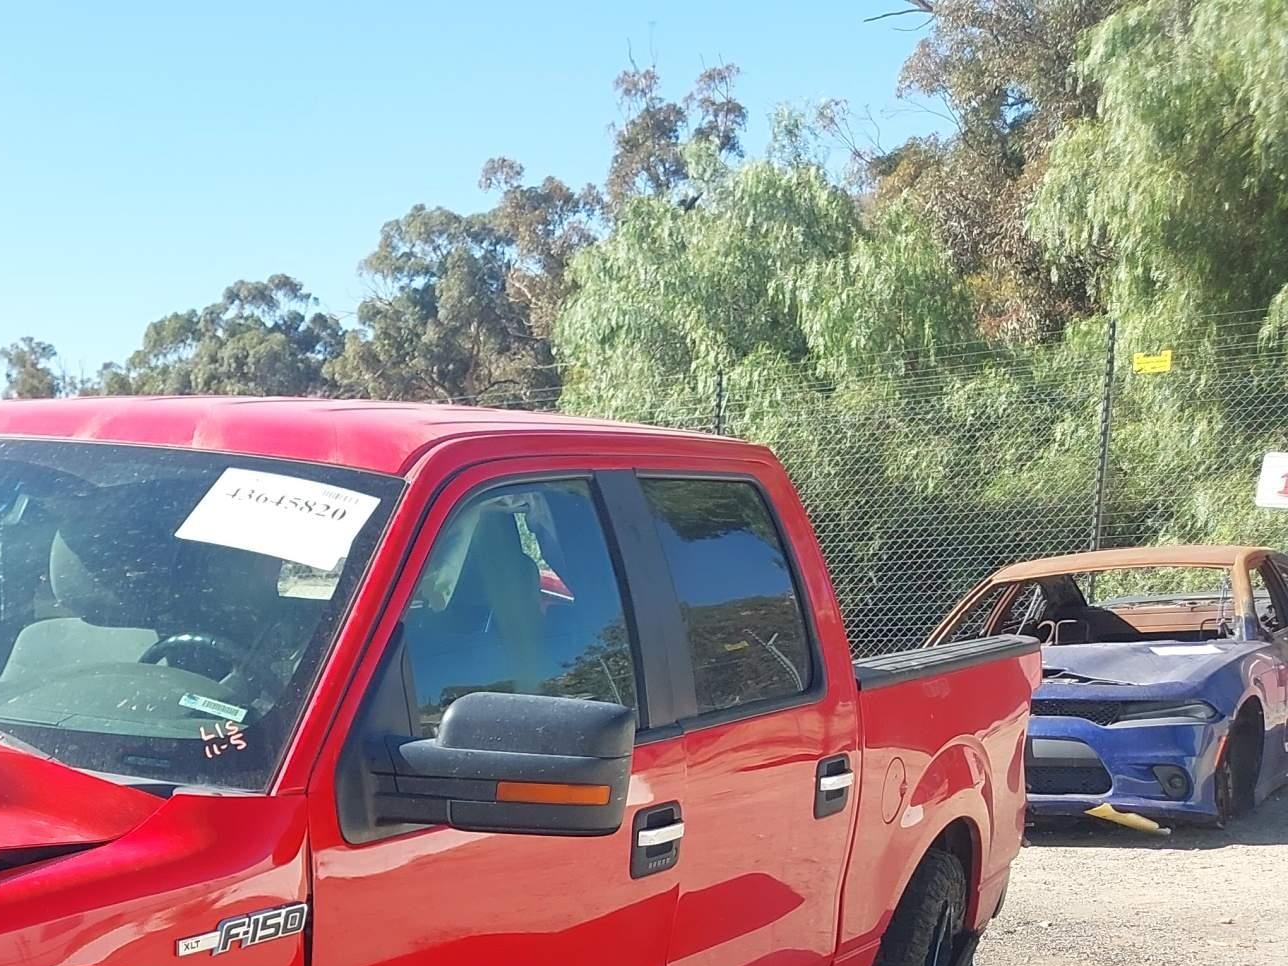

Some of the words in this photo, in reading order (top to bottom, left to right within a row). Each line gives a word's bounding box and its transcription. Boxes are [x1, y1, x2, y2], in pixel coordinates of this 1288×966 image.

[225, 487, 348, 521] 43645820
[183, 940, 201, 951] XLT
[216, 903, 308, 955] F-150
